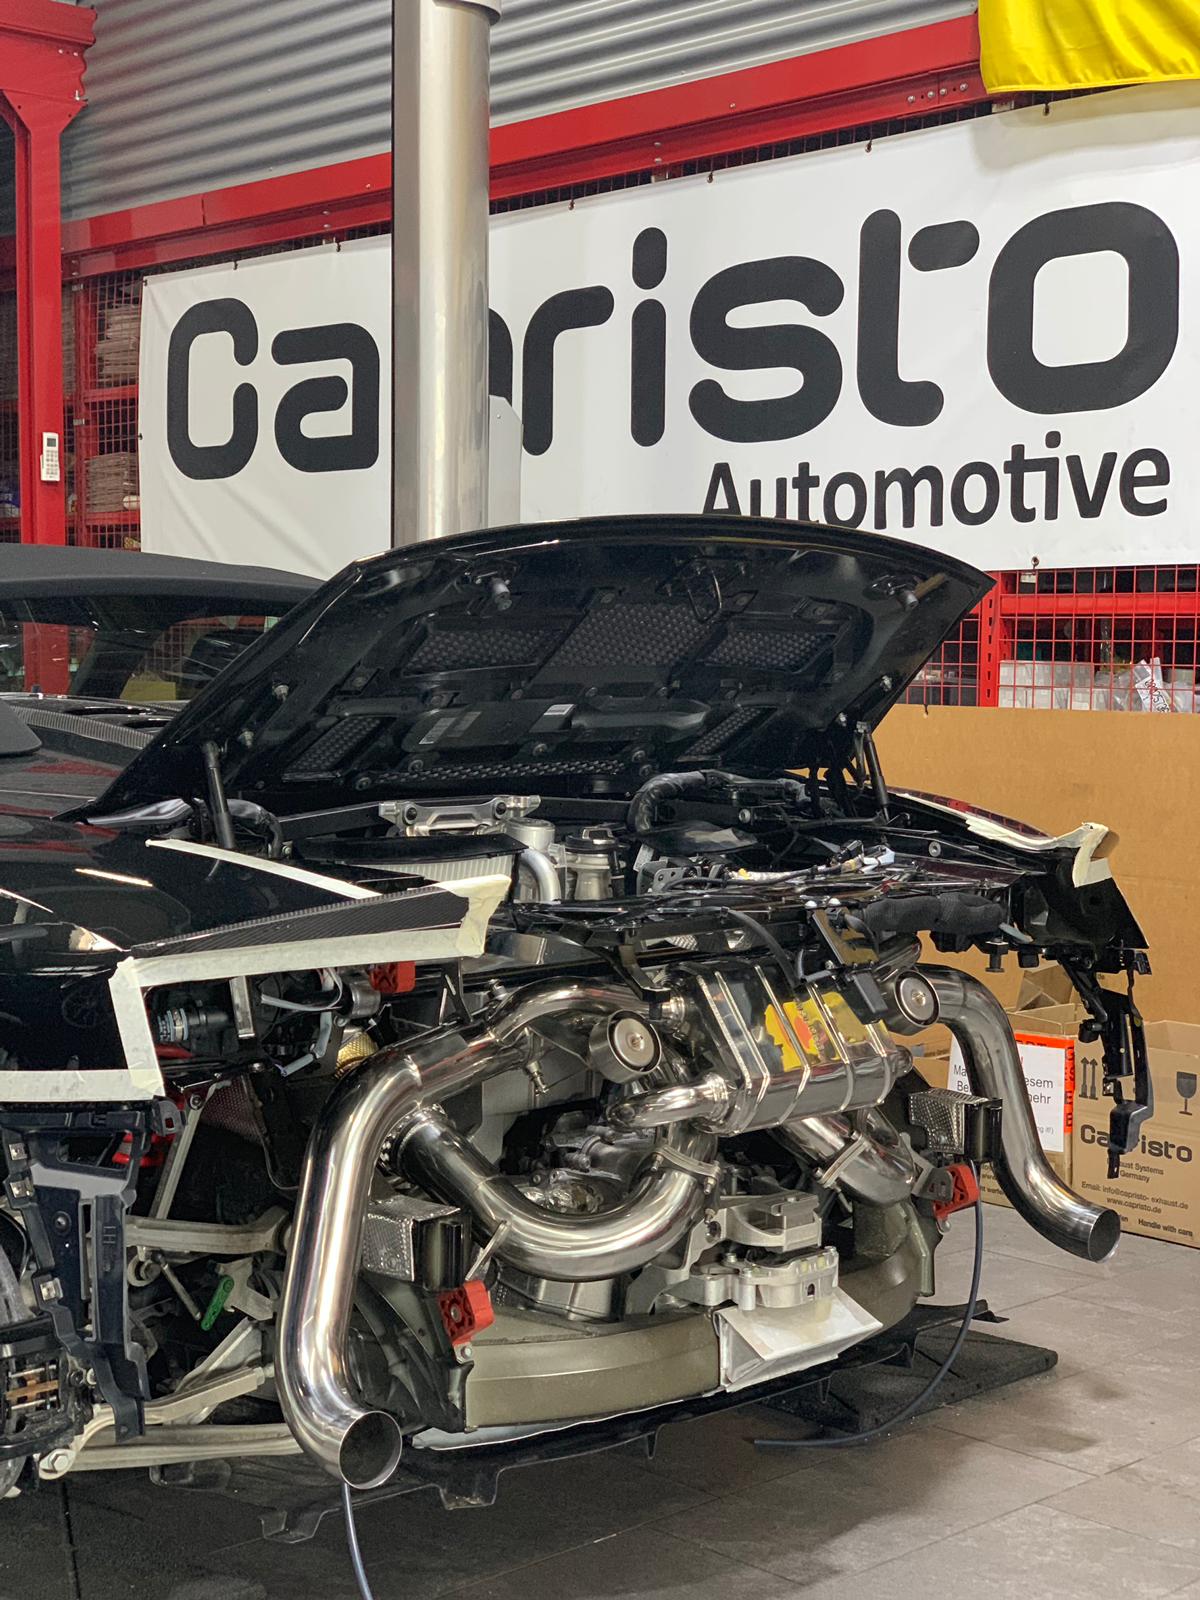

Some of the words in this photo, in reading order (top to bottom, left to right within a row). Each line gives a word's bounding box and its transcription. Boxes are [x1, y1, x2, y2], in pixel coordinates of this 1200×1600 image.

[702, 431, 1171, 530] Automotive
[1024, 1077, 1054, 1089] esem
[1080, 1123, 1193, 1163] Caisto
[1135, 1163, 1165, 1175] Systems
[1119, 1170, 1151, 1183] Germany
[1137, 1218, 1161, 1230] Handle
[1162, 1224, 1177, 1234] with
